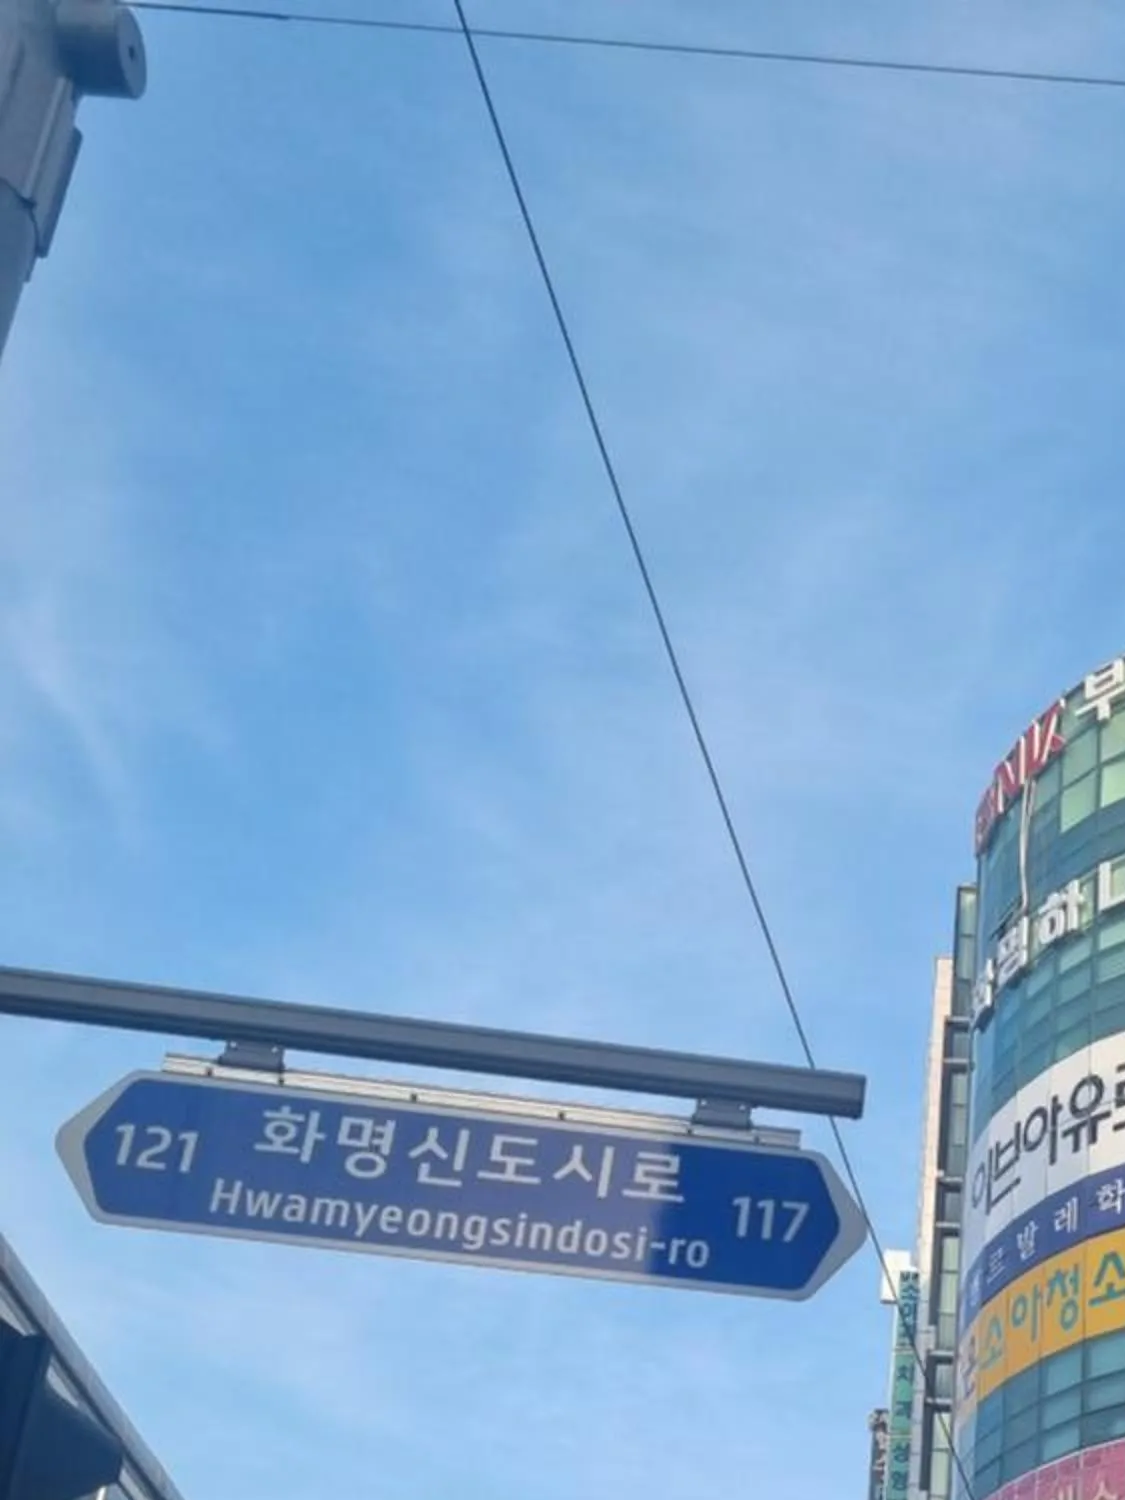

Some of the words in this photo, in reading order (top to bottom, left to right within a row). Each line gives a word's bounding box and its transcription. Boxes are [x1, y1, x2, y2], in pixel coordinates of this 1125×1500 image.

[112, 1123, 200, 1174] 121
[254, 1105, 686, 1206] 화명신도시로
[732, 1195, 810, 1243] 117
[208, 1178, 710, 1269] Hwamyeongsindosi-ro
